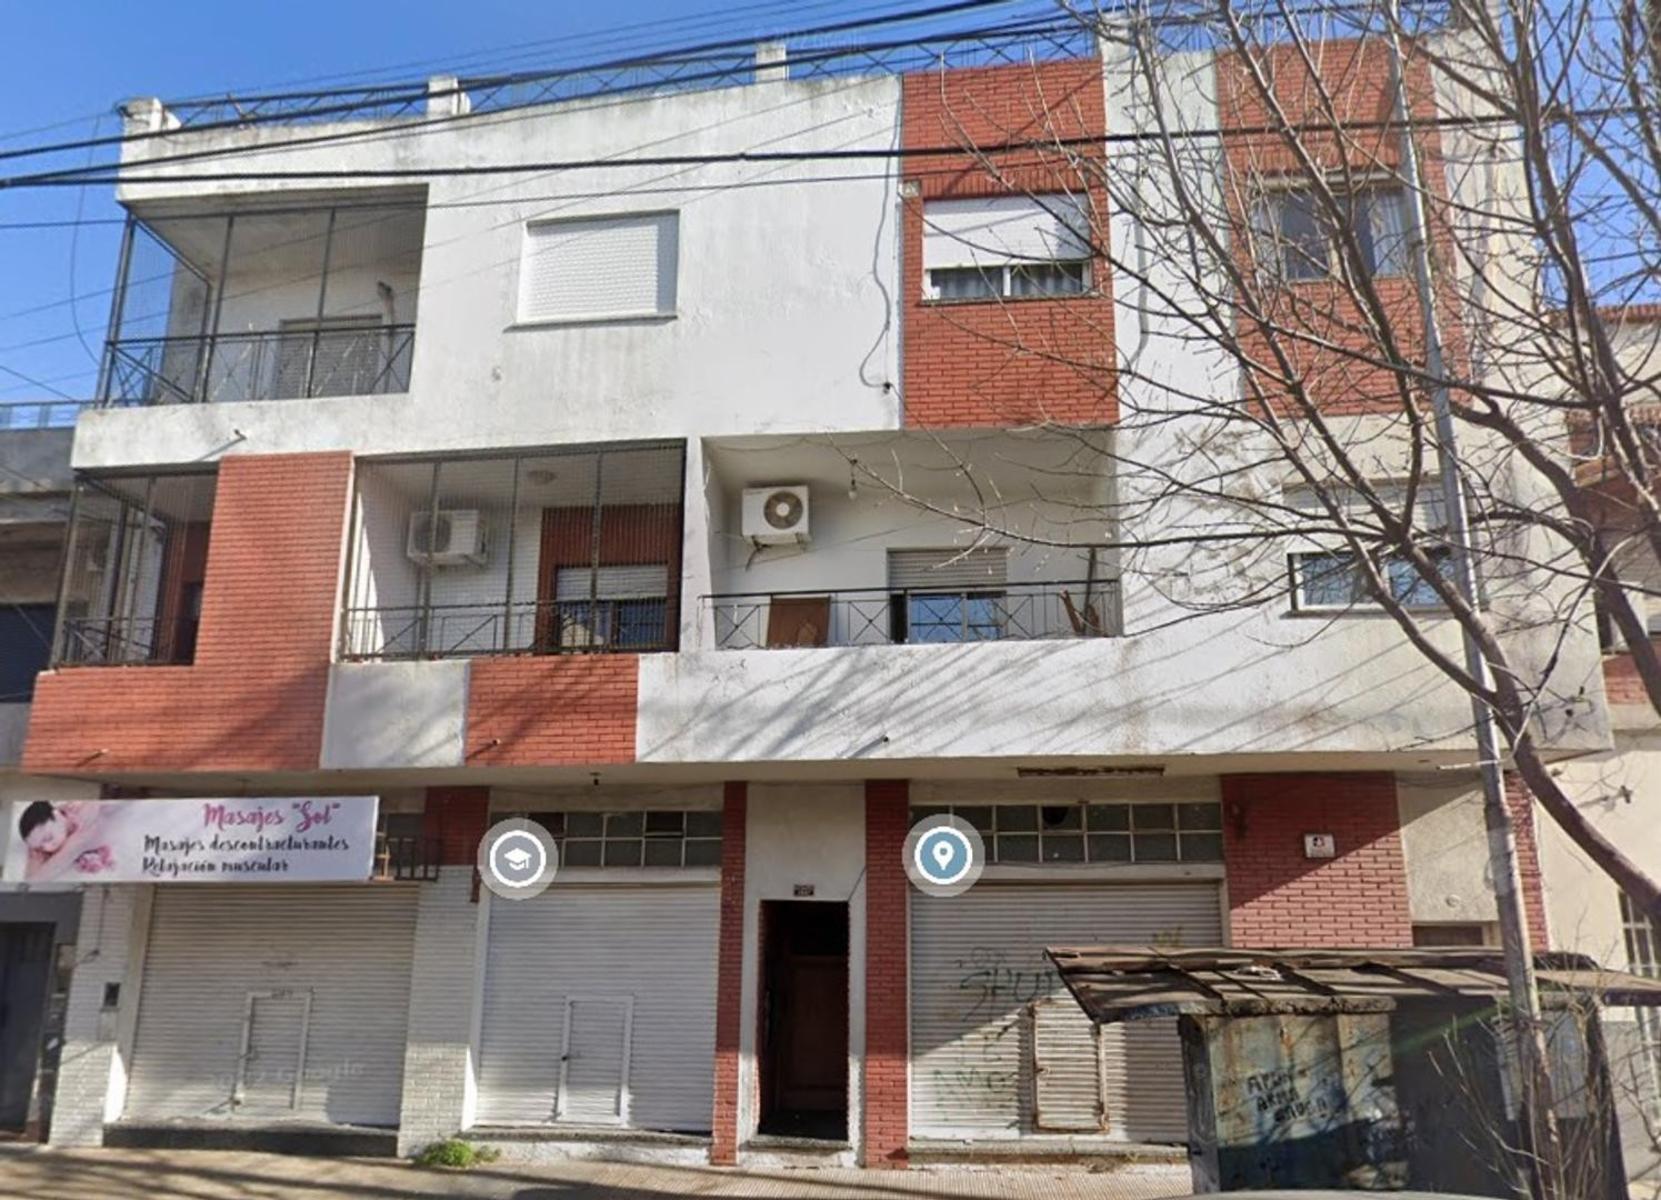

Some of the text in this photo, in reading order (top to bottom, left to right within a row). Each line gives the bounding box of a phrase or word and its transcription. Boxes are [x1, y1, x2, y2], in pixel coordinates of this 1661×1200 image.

[204, 801, 341, 832] Masajes "Sol"
[145, 833, 350, 856] Masajes descontracturantes
[221, 857, 288, 872] muscular
